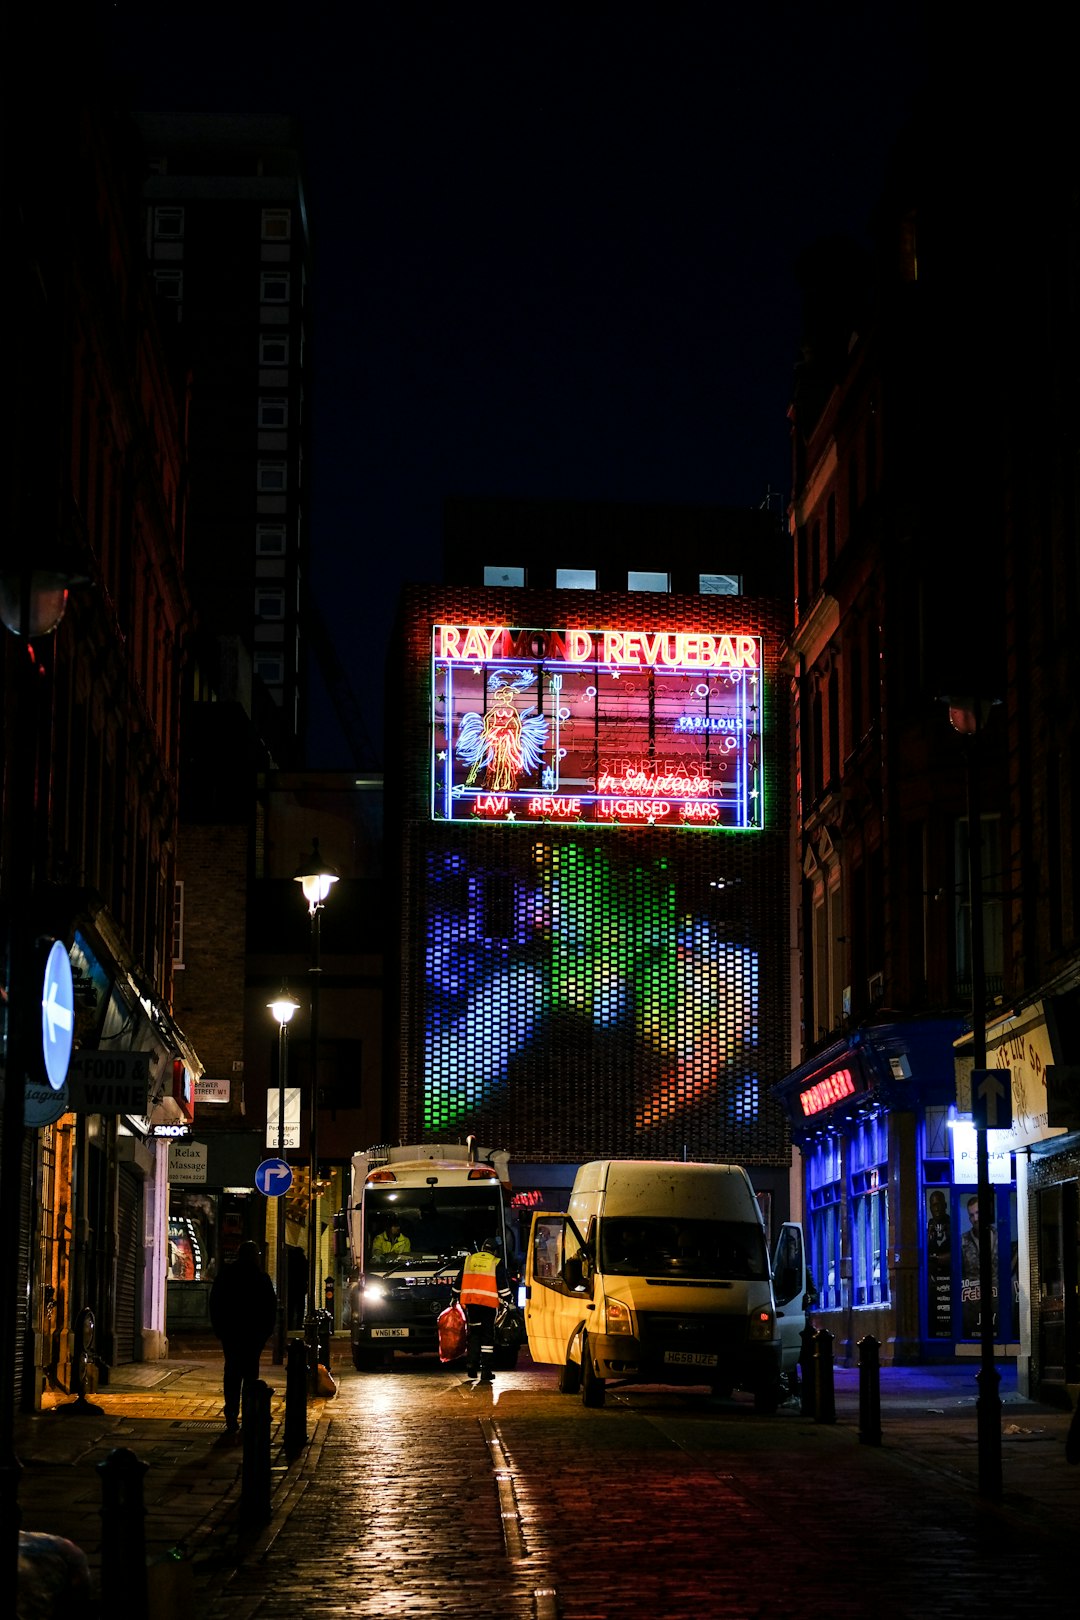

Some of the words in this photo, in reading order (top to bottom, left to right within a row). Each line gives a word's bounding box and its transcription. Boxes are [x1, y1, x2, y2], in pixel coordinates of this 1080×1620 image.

[440, 627, 592, 662] RAYMOND
[603, 632, 757, 668] REVUEBAR
[679, 716, 743, 730] FABULOUS
[532, 797, 581, 813] REVUE
[601, 799, 670, 816] LICENSED
[684, 802, 719, 816] BARS
[84, 1058, 126, 1080] FOOD
[132, 1060, 145, 1080] &
[85, 1085, 144, 1106] WINE
[175, 1148, 201, 1158] Relax
[169, 1160, 206, 1172] Massage
